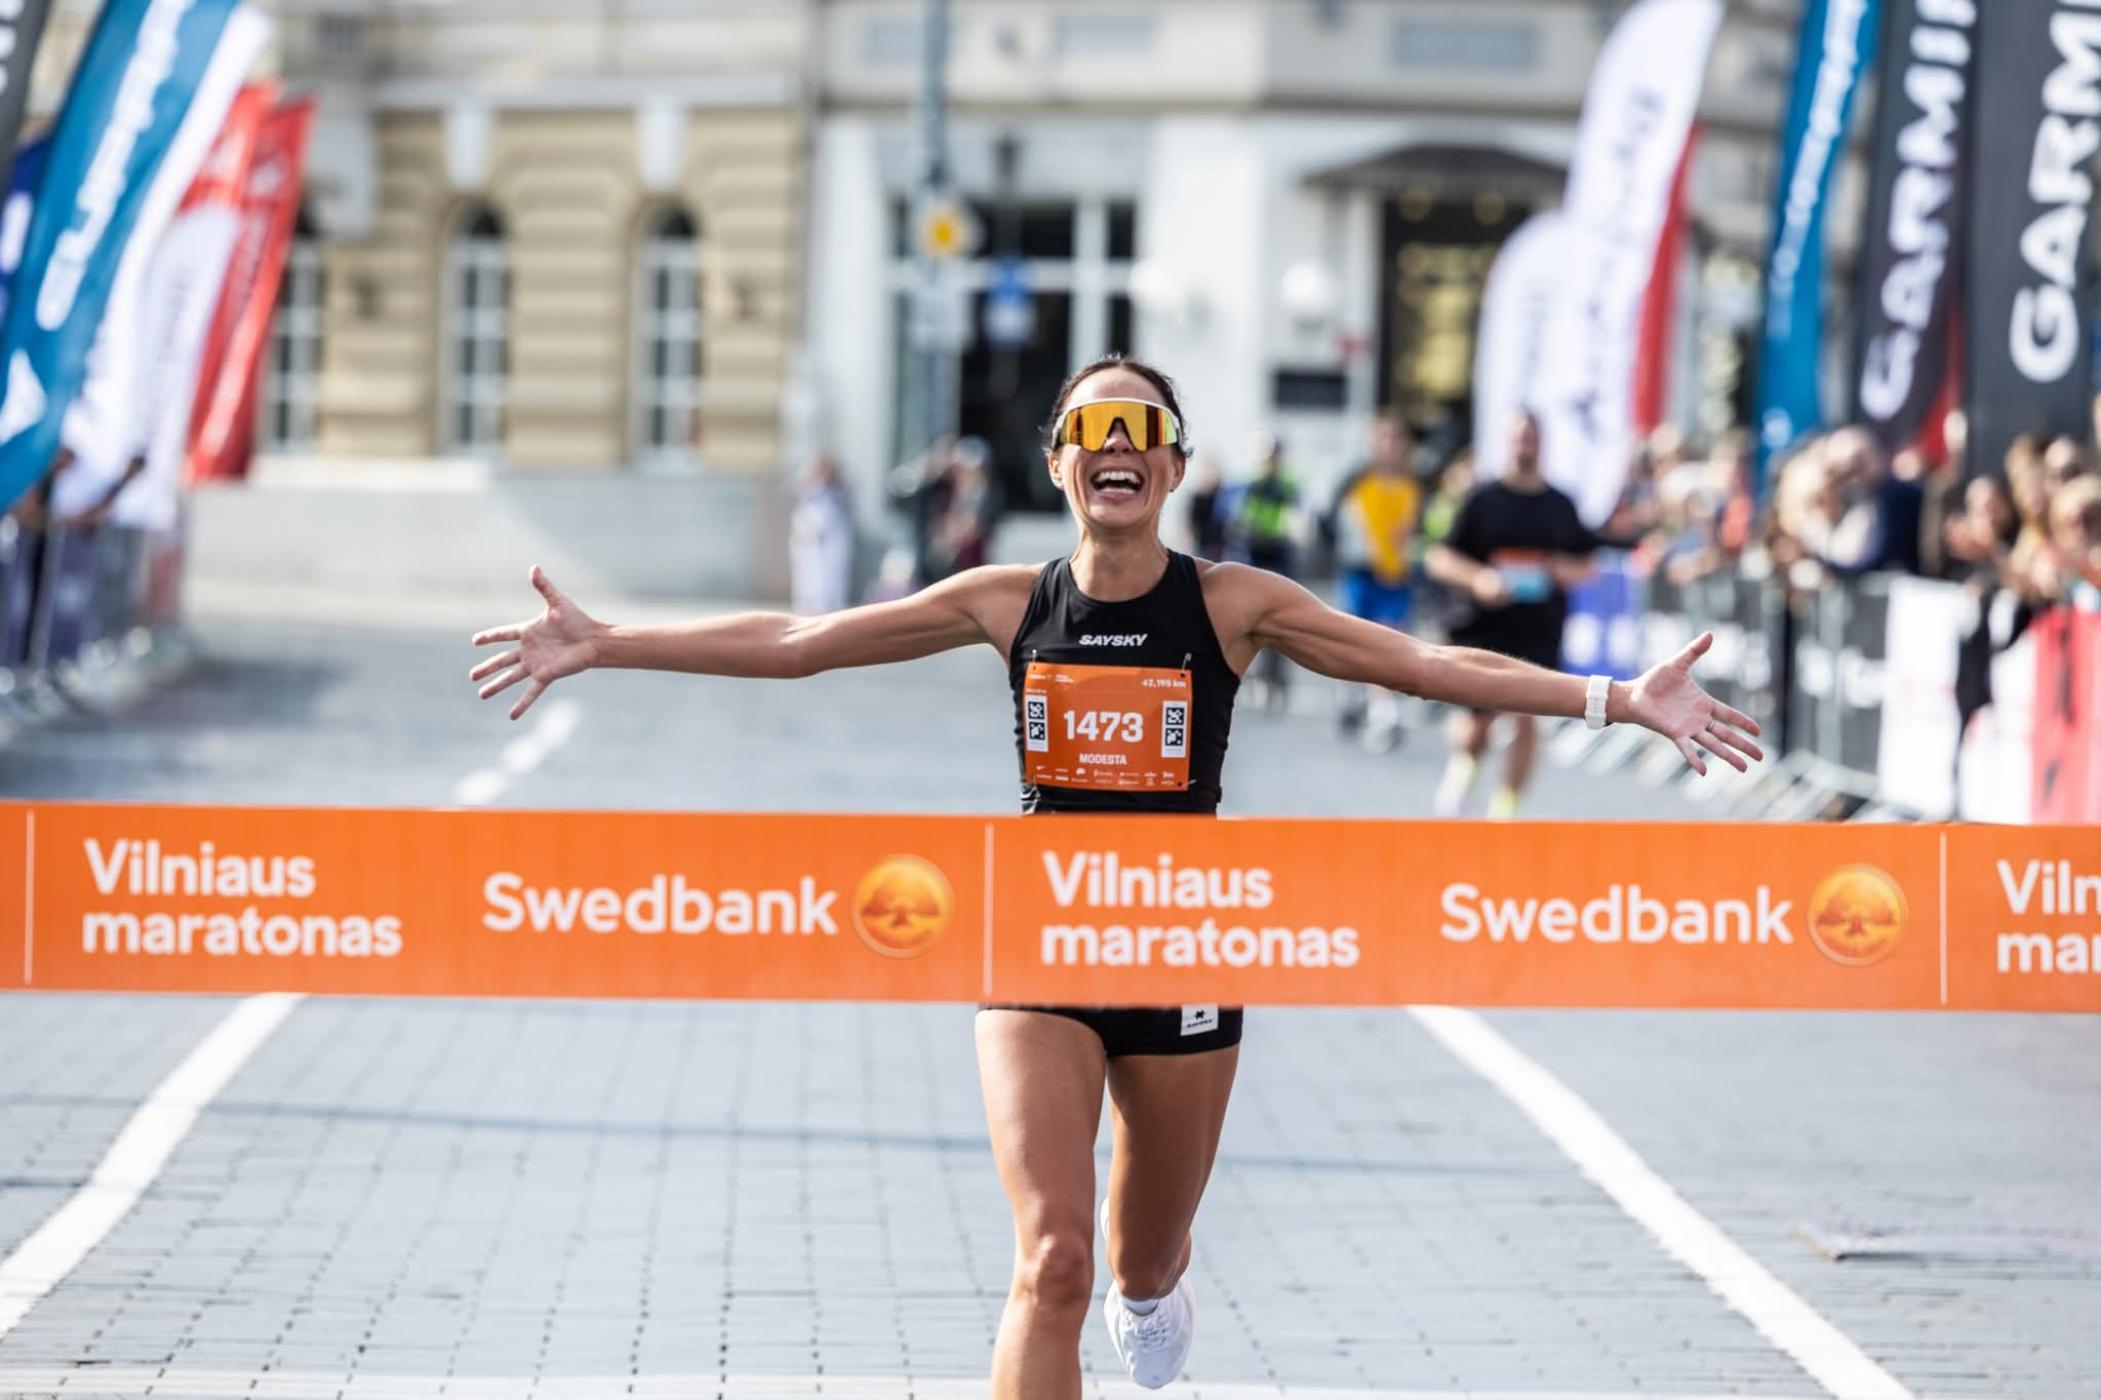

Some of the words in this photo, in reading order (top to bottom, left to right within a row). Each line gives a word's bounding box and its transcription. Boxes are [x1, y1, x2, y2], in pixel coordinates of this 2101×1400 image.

[2010, 0, 2101, 383] GARM
[1078, 633, 1148, 647] SAYSKY
[1063, 709, 1144, 743] 1473
[1079, 753, 1127, 765] MODESTA
[84, 838, 315, 897] Vilniaus
[1042, 850, 1273, 909] Vilniaus
[1996, 859, 2101, 915] Viln
[83, 907, 402, 957] maratonas
[482, 873, 838, 935] Swedbank
[1440, 883, 1793, 944] Swedbank
[1041, 918, 1361, 968] maratonas
